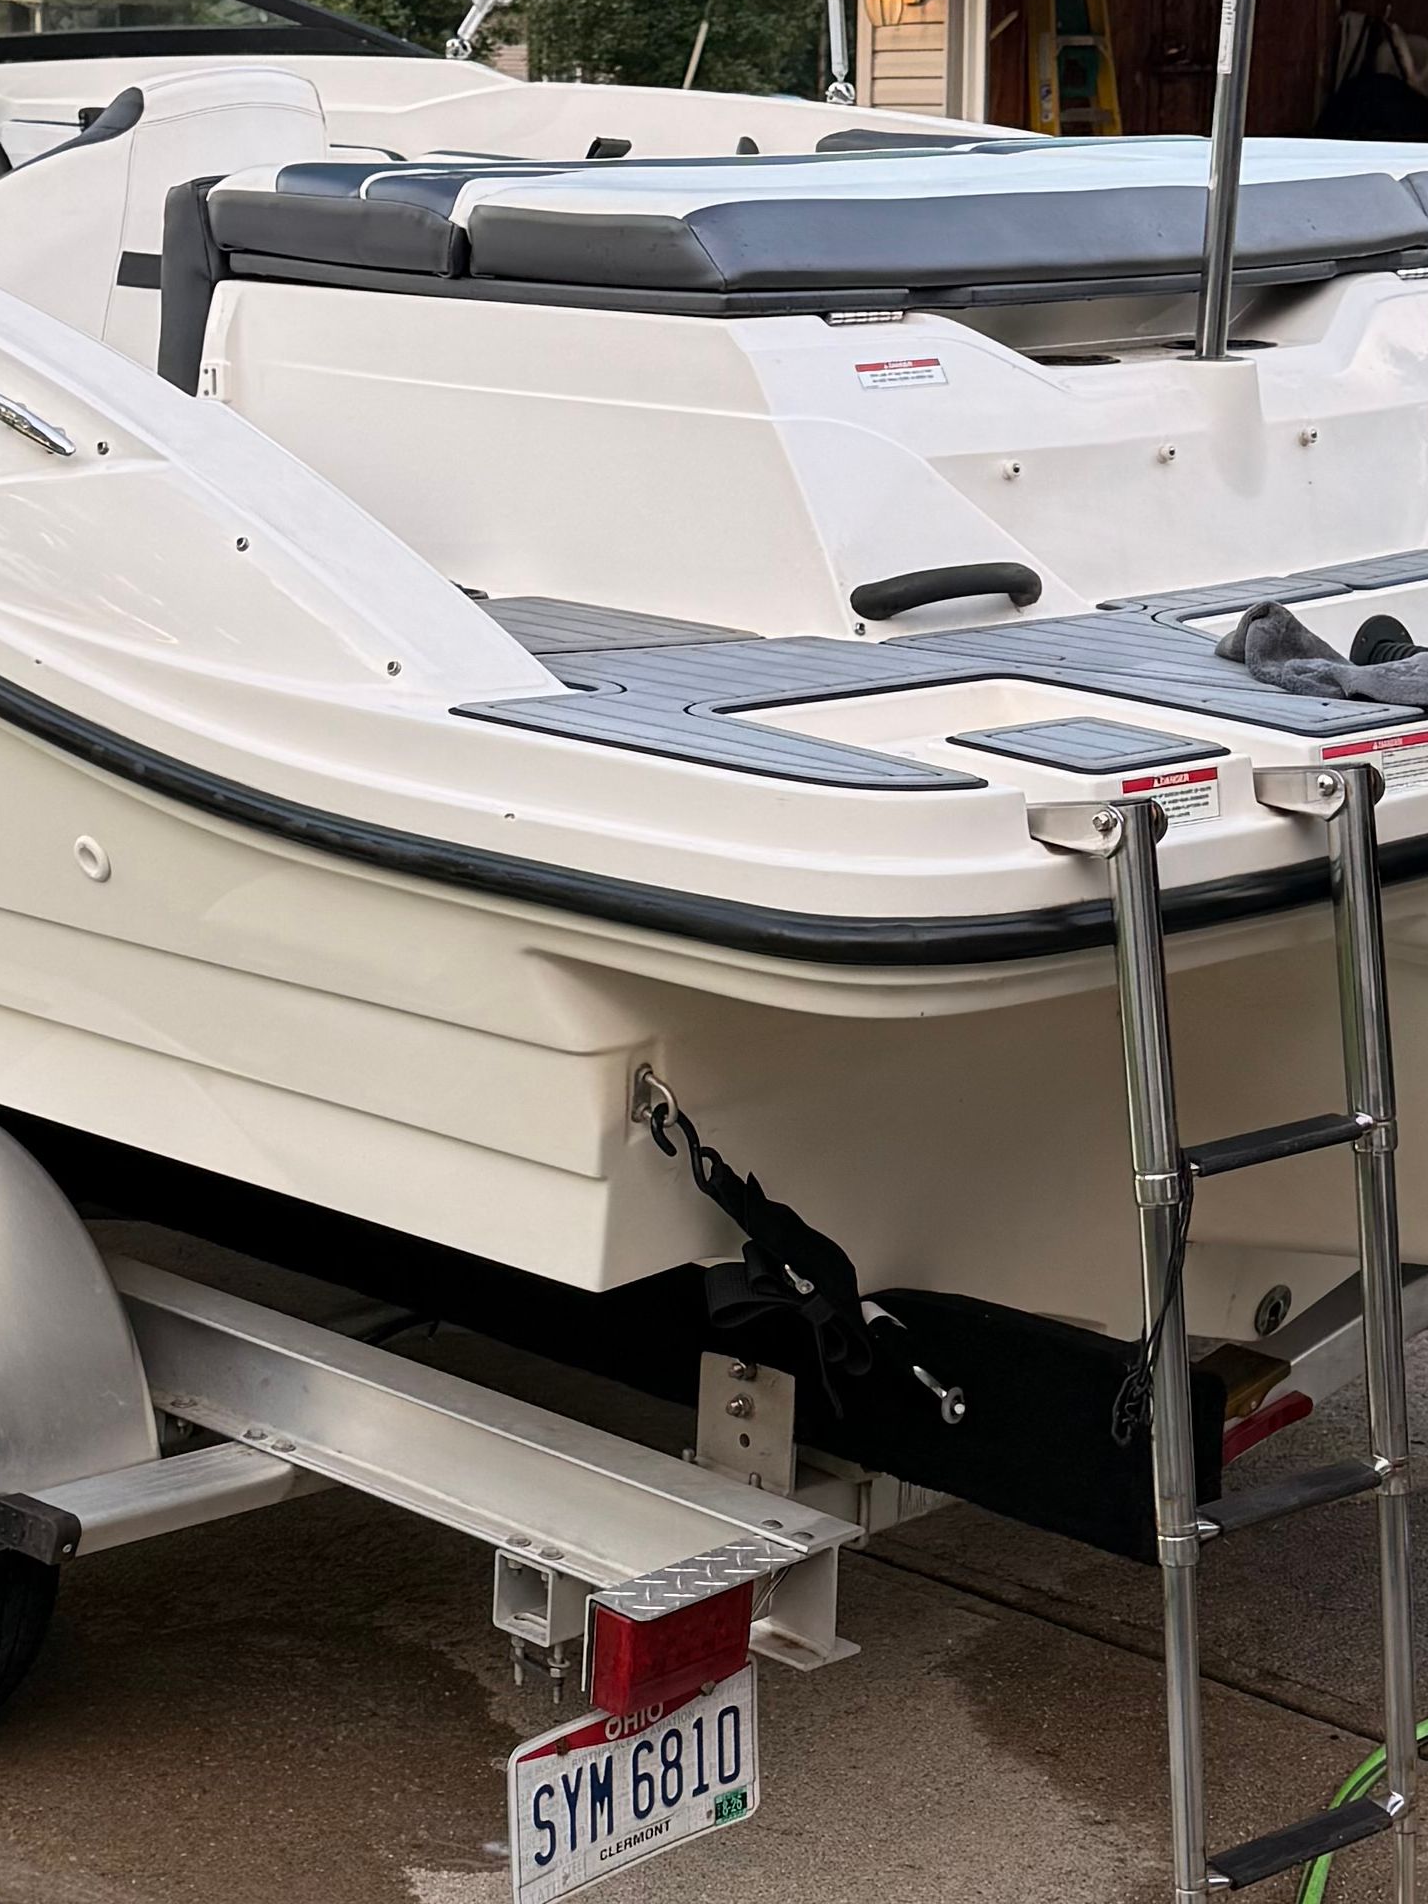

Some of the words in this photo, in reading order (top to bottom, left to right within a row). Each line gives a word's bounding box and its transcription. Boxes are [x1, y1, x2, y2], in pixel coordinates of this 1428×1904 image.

[605, 1703, 664, 1741] OHIO
[533, 1754, 613, 1866] SYM
[632, 1705, 741, 1820] 6810
[600, 1819, 673, 1862] CLERMONT
